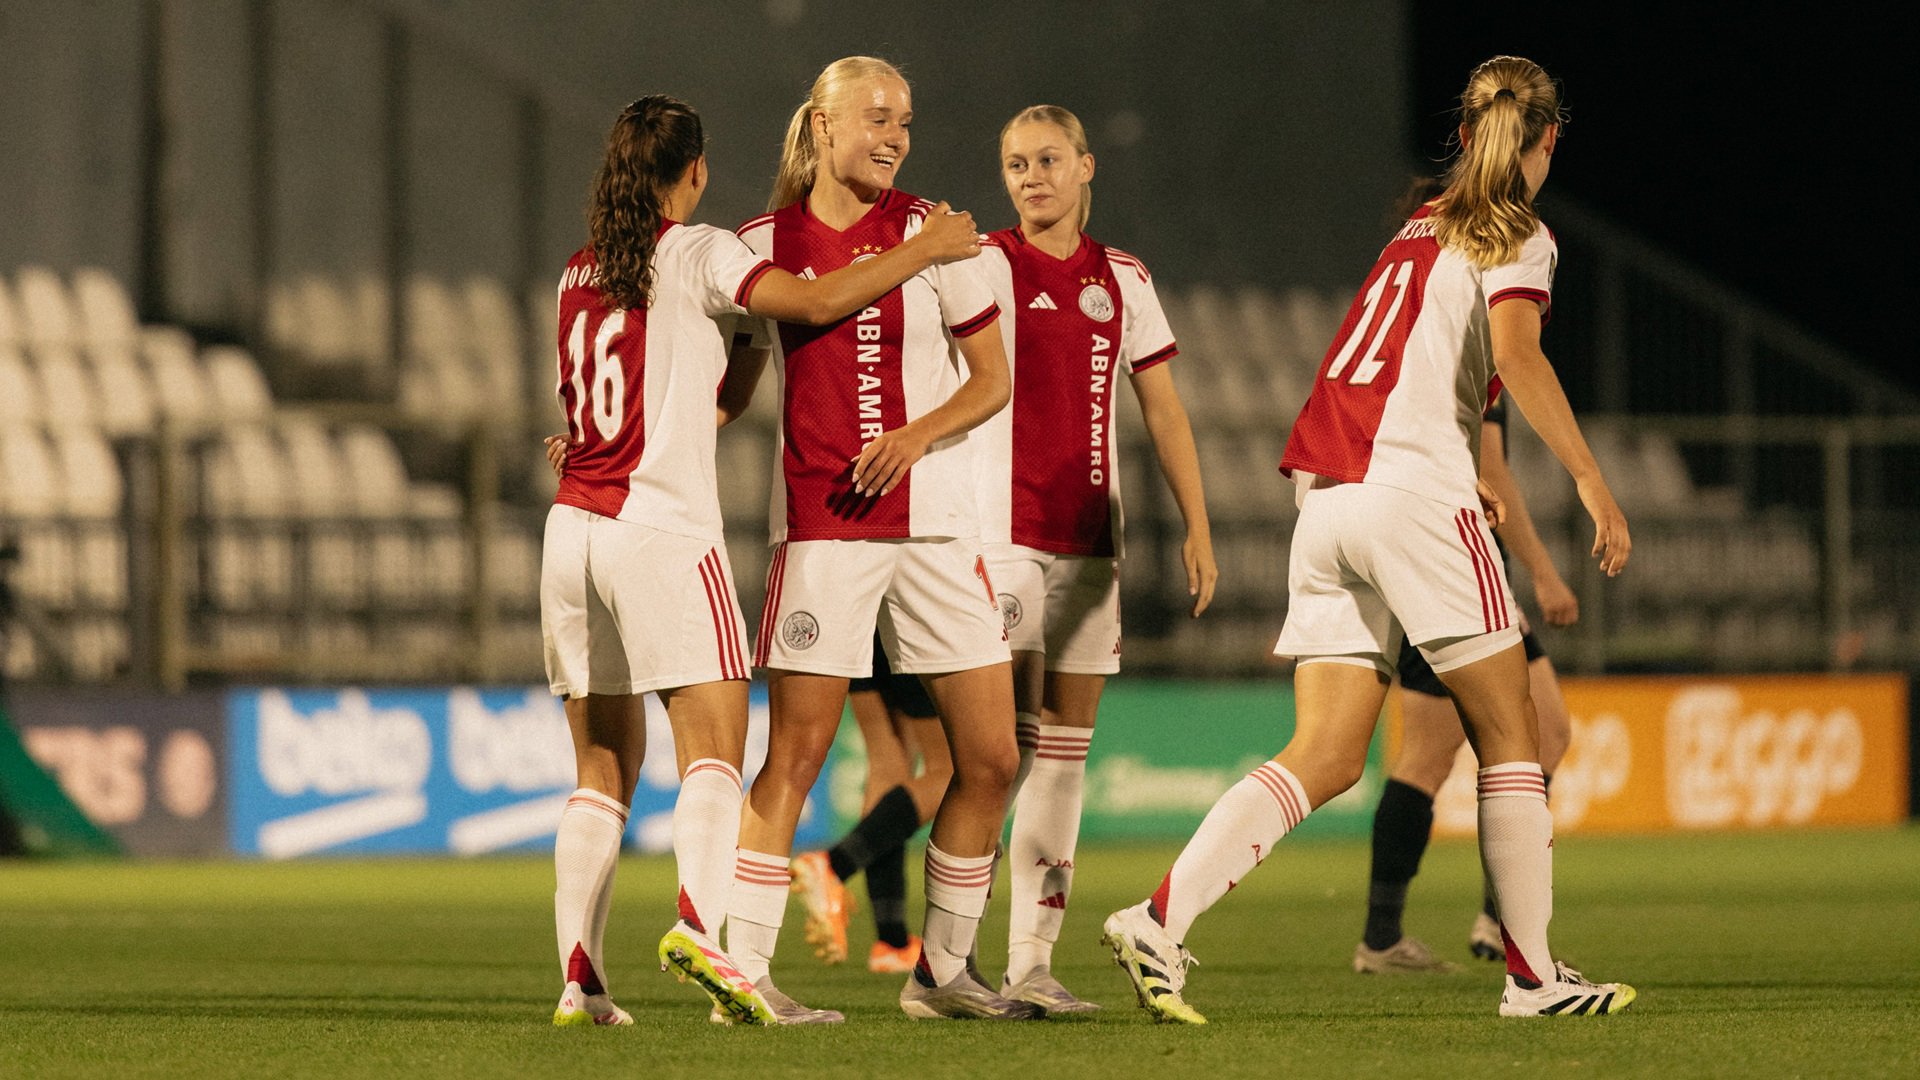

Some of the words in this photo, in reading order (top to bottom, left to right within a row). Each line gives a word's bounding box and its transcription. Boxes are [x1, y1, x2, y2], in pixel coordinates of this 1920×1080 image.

[568, 308, 625, 443] 16
[1325, 258, 1414, 386] 12
[1034, 857, 1075, 869] AJA
